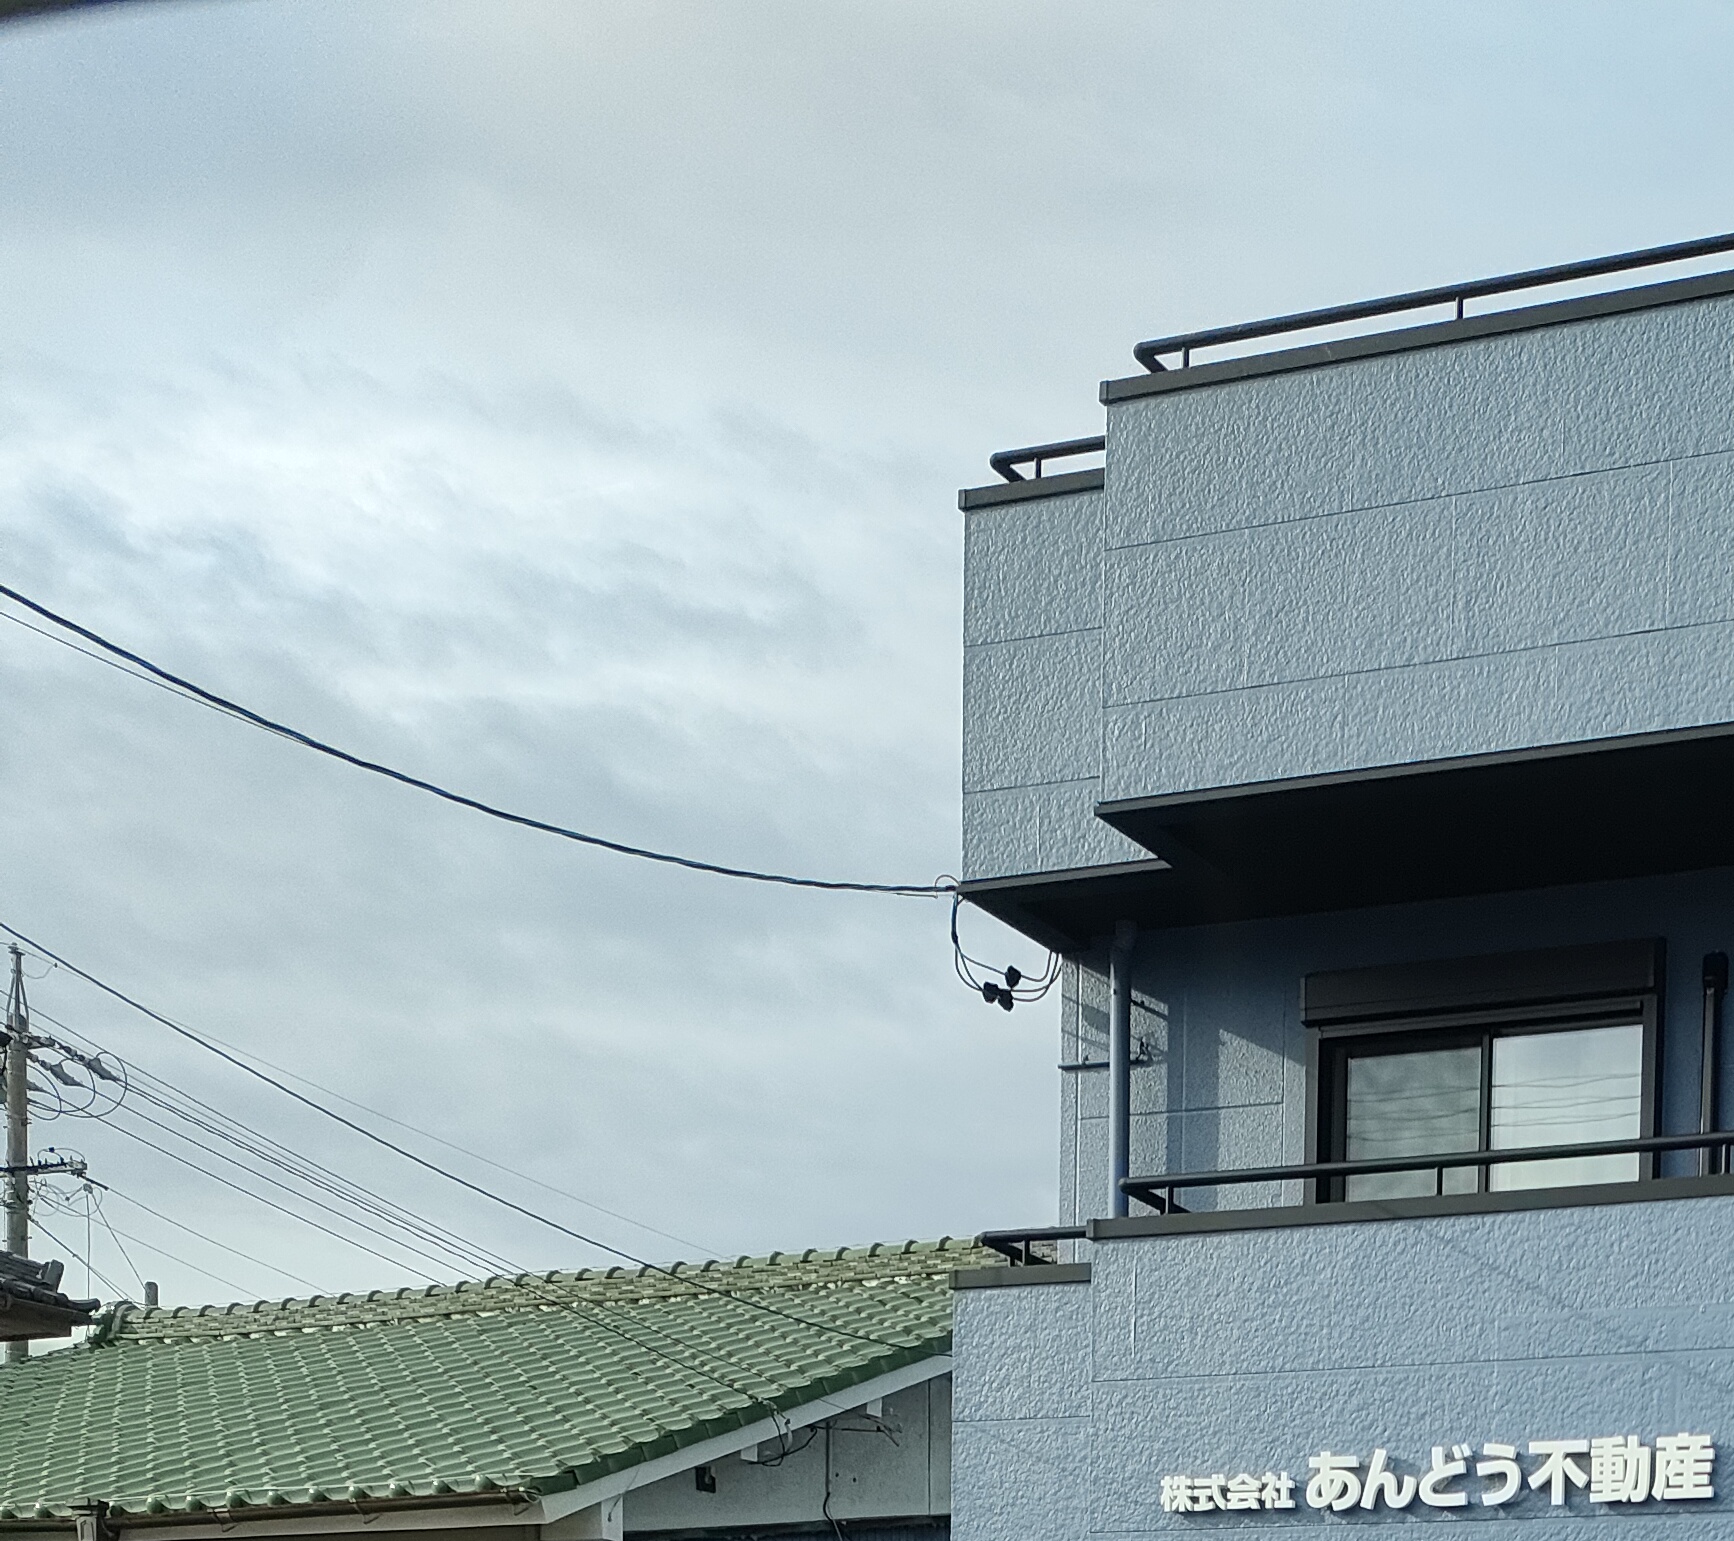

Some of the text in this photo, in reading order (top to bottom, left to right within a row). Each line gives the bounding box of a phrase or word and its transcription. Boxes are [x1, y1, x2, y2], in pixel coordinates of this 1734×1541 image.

[1160, 1432, 1716, 1512] 株式会社 あんどう不動産
